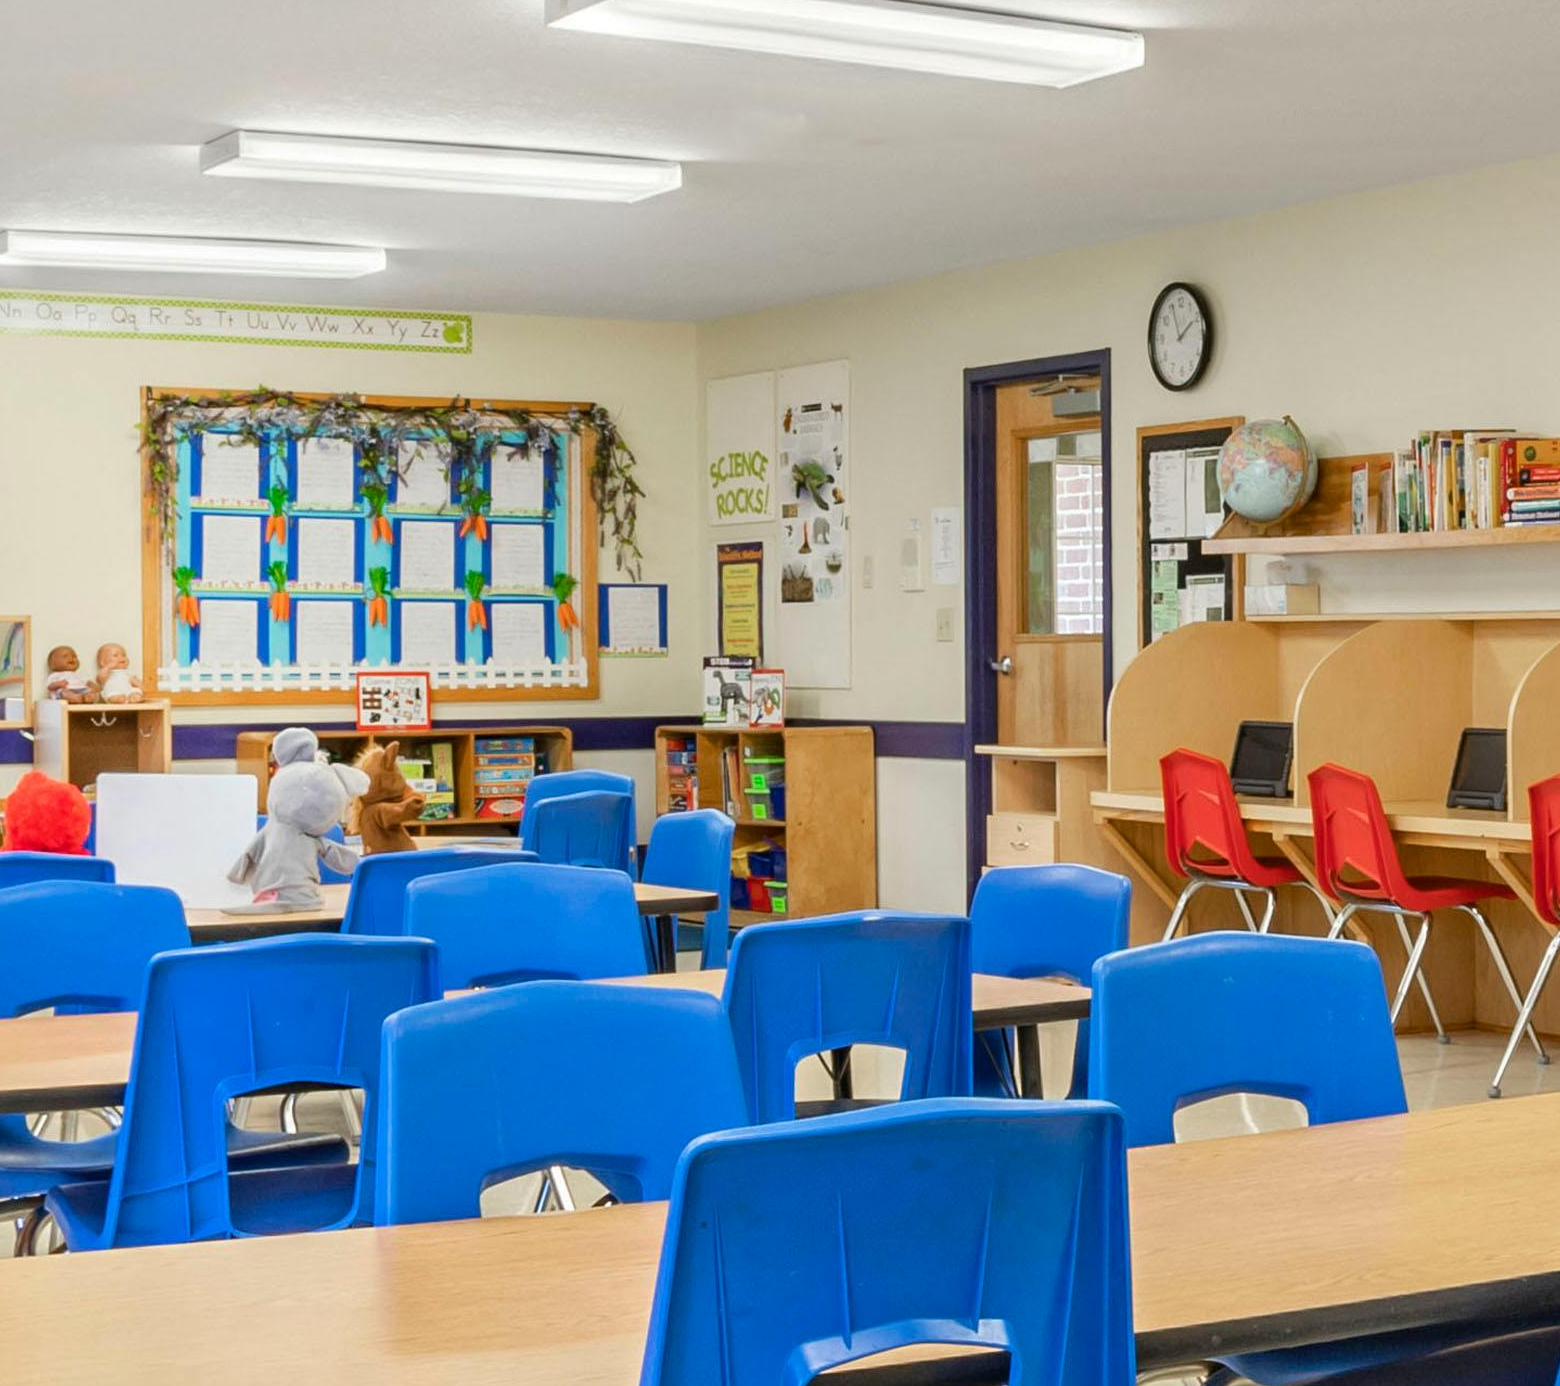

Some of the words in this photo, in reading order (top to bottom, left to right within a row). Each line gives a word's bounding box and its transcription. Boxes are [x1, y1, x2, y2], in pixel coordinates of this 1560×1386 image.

[149, 306, 171, 325] Rr
[306, 318, 340, 335] Ww
[709, 450, 770, 489] SCIENCE
[715, 483, 771, 520] ROCKS!
